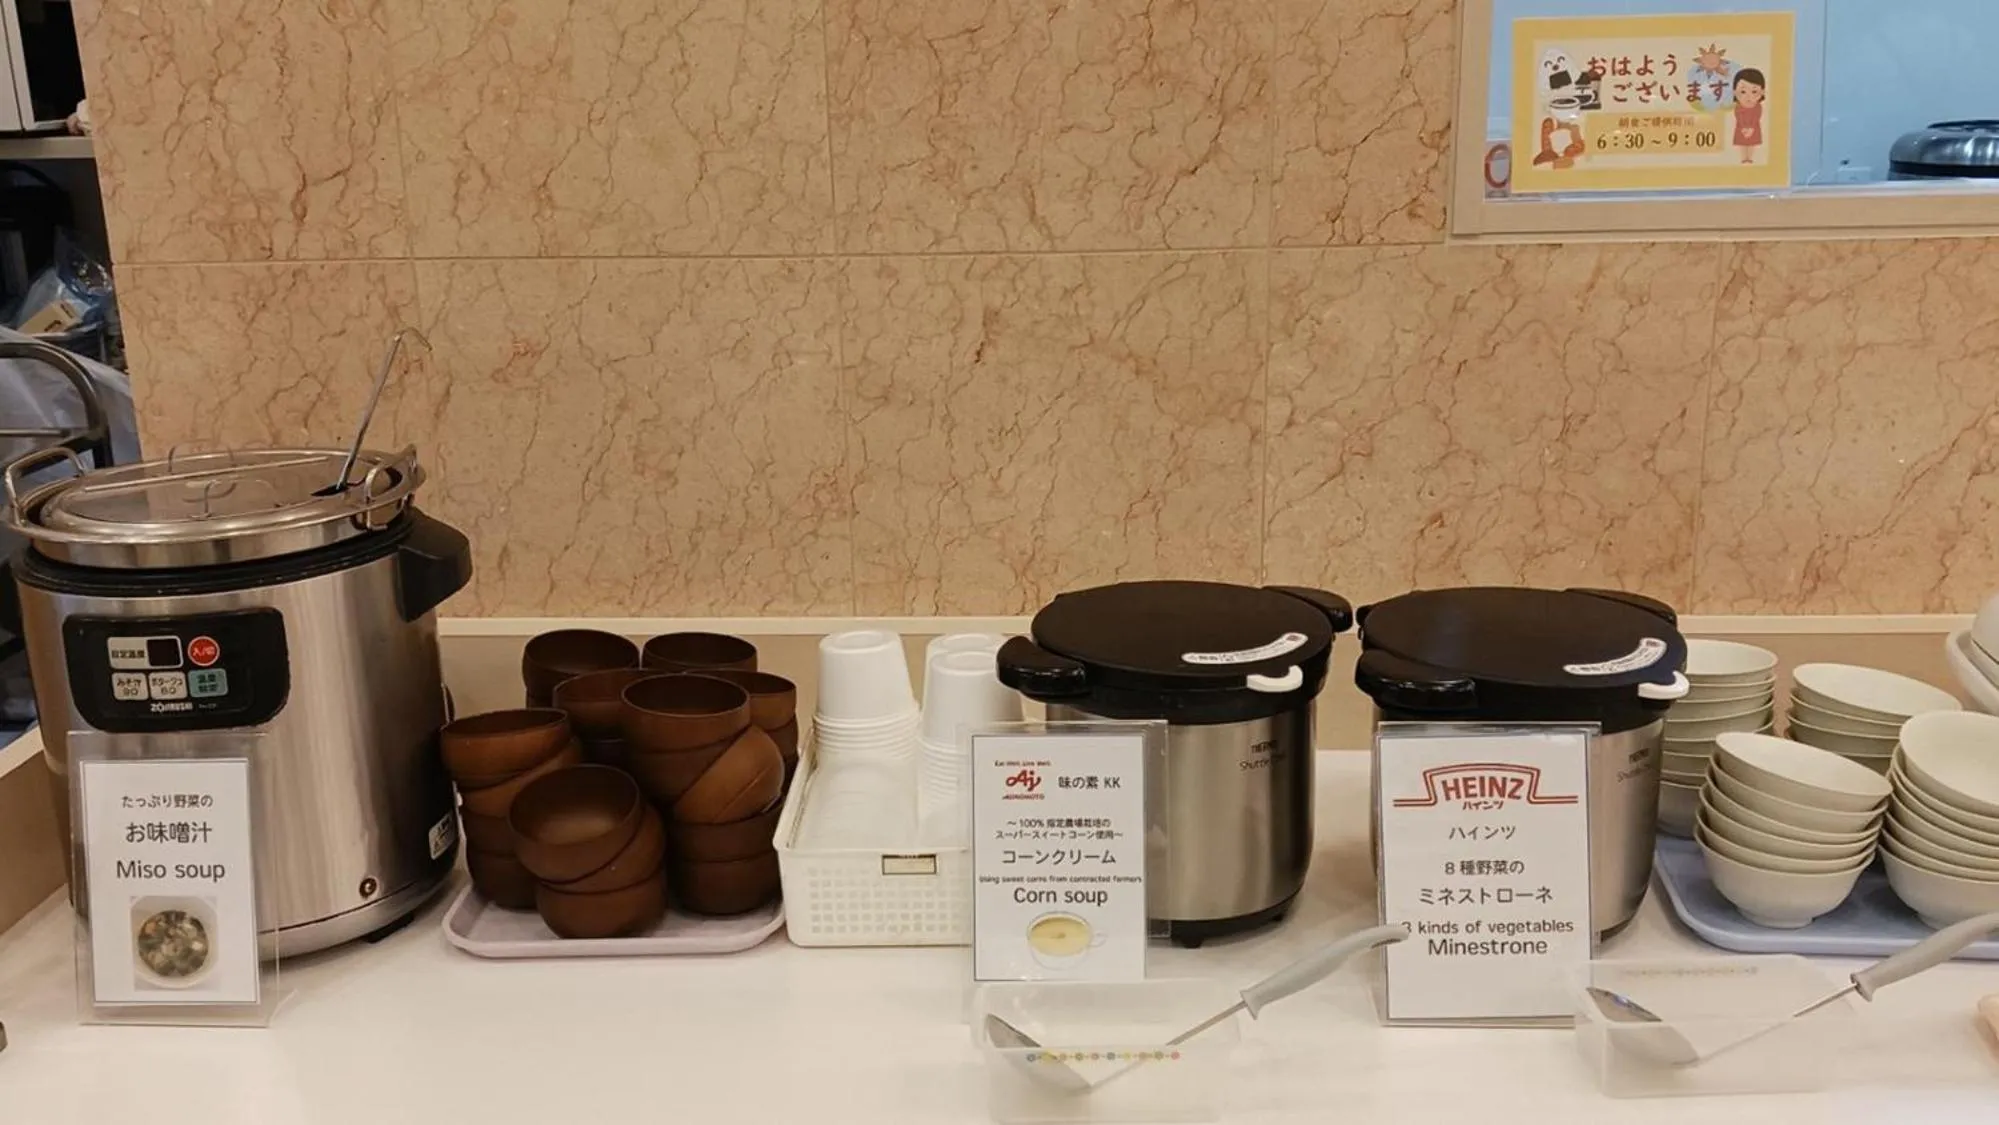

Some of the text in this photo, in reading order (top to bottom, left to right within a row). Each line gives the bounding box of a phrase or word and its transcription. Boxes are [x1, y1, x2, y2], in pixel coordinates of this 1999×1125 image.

[1587, 53, 1677, 77] おはよう
[1612, 80, 1728, 103] ございます
[1441, 776, 1525, 801] HEINZ
[122, 794, 214, 808] たっぷり野菜の
[1462, 801, 1504, 811] ハインツ
[125, 821, 213, 844] お味噌汁
[1449, 826, 1516, 840] ハインツ
[1002, 849, 1117, 865] コーンクリーム
[116, 860, 225, 883] Miso soup
[1049, 875, 1068, 883] from
[1013, 887, 1109, 907] Corn soup
[1419, 886, 1554, 906] ミネストローネ
[1418, 921, 1459, 935] kinds
[1465, 920, 1482, 934] of
[1488, 919, 1574, 936] vegetables
[1428, 938, 1548, 956] Minestrone
